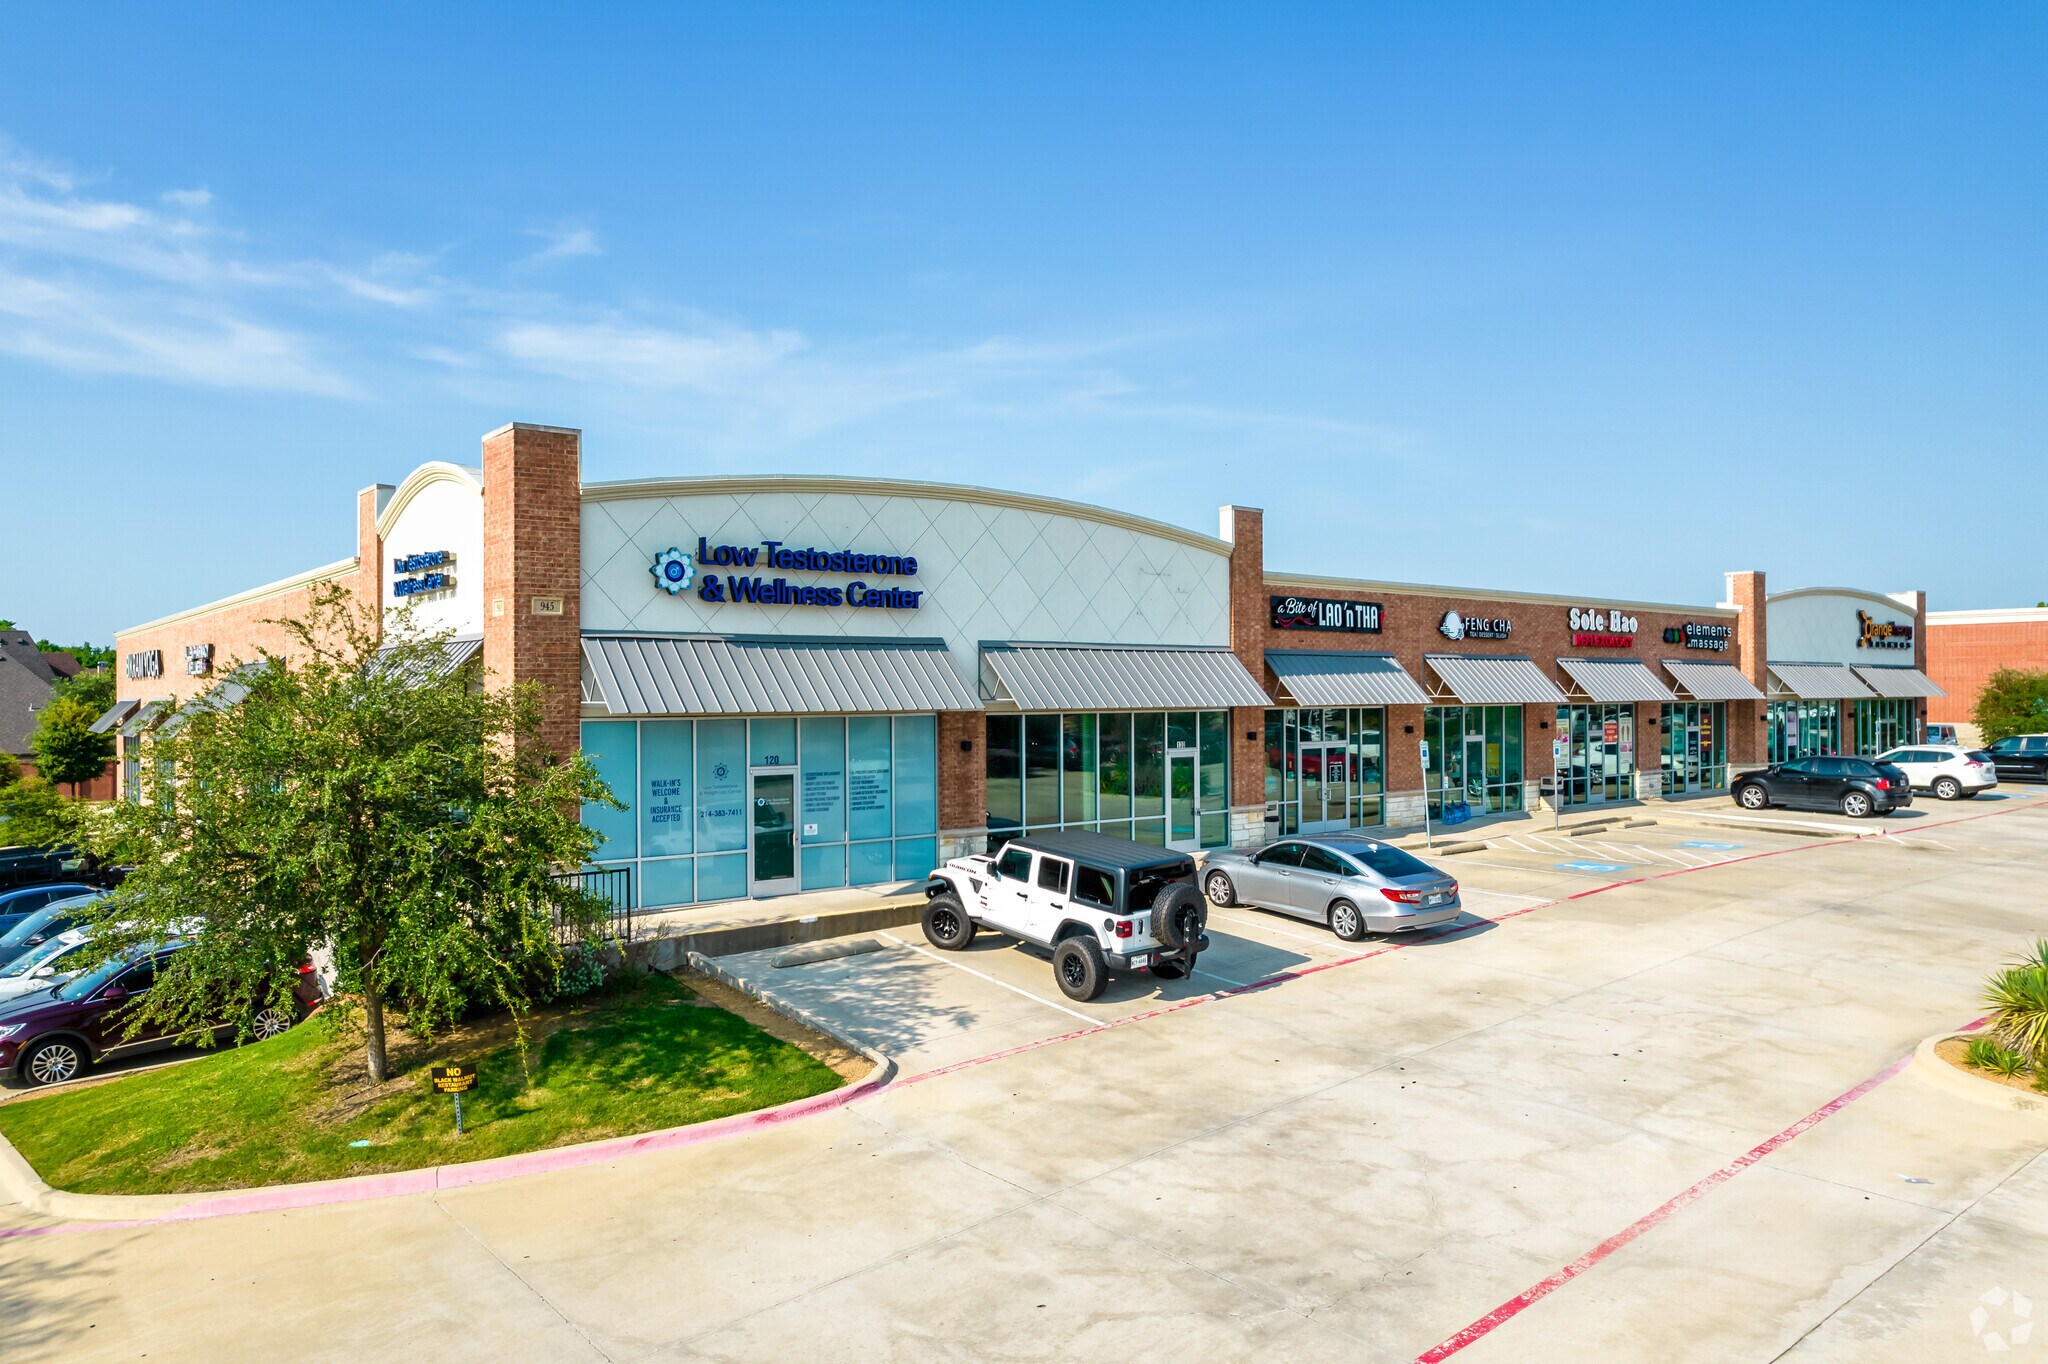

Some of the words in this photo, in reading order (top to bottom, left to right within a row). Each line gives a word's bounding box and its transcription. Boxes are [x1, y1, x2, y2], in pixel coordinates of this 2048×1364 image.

[698, 537, 759, 567] Low
[761, 541, 918, 576] Testosterone
[699, 575, 727, 602] &
[727, 576, 843, 606] Wellness
[846, 581, 924, 609] Center
[540, 601, 555, 611] 945
[1277, 604, 1285, 614] a
[1285, 597, 1307, 614] Bite
[1307, 600, 1318, 618] of
[1465, 617, 1490, 631] FENG
[1493, 619, 1512, 632] CHA
[1570, 607, 1604, 631] Sole
[1609, 609, 1638, 633] Hao
[1686, 622, 1732, 637] elements
[1690, 638, 1729, 652] massage
[764, 755, 780, 765] 120
[650, 779, 682, 788] WALK-IN'S
[651, 787, 680, 797] WELCOME
[663, 797, 669, 805] &
[650, 804, 682, 814] INSURANCE
[700, 808, 742, 818] 214-383-7411
[651, 814, 681, 823] ACCEPTED
[446, 1067, 461, 1077] NO
[452, 1073, 476, 1083] WALNUT
[437, 1079, 473, 1088] RESTAURANT
[443, 1085, 468, 1093] PARKING
